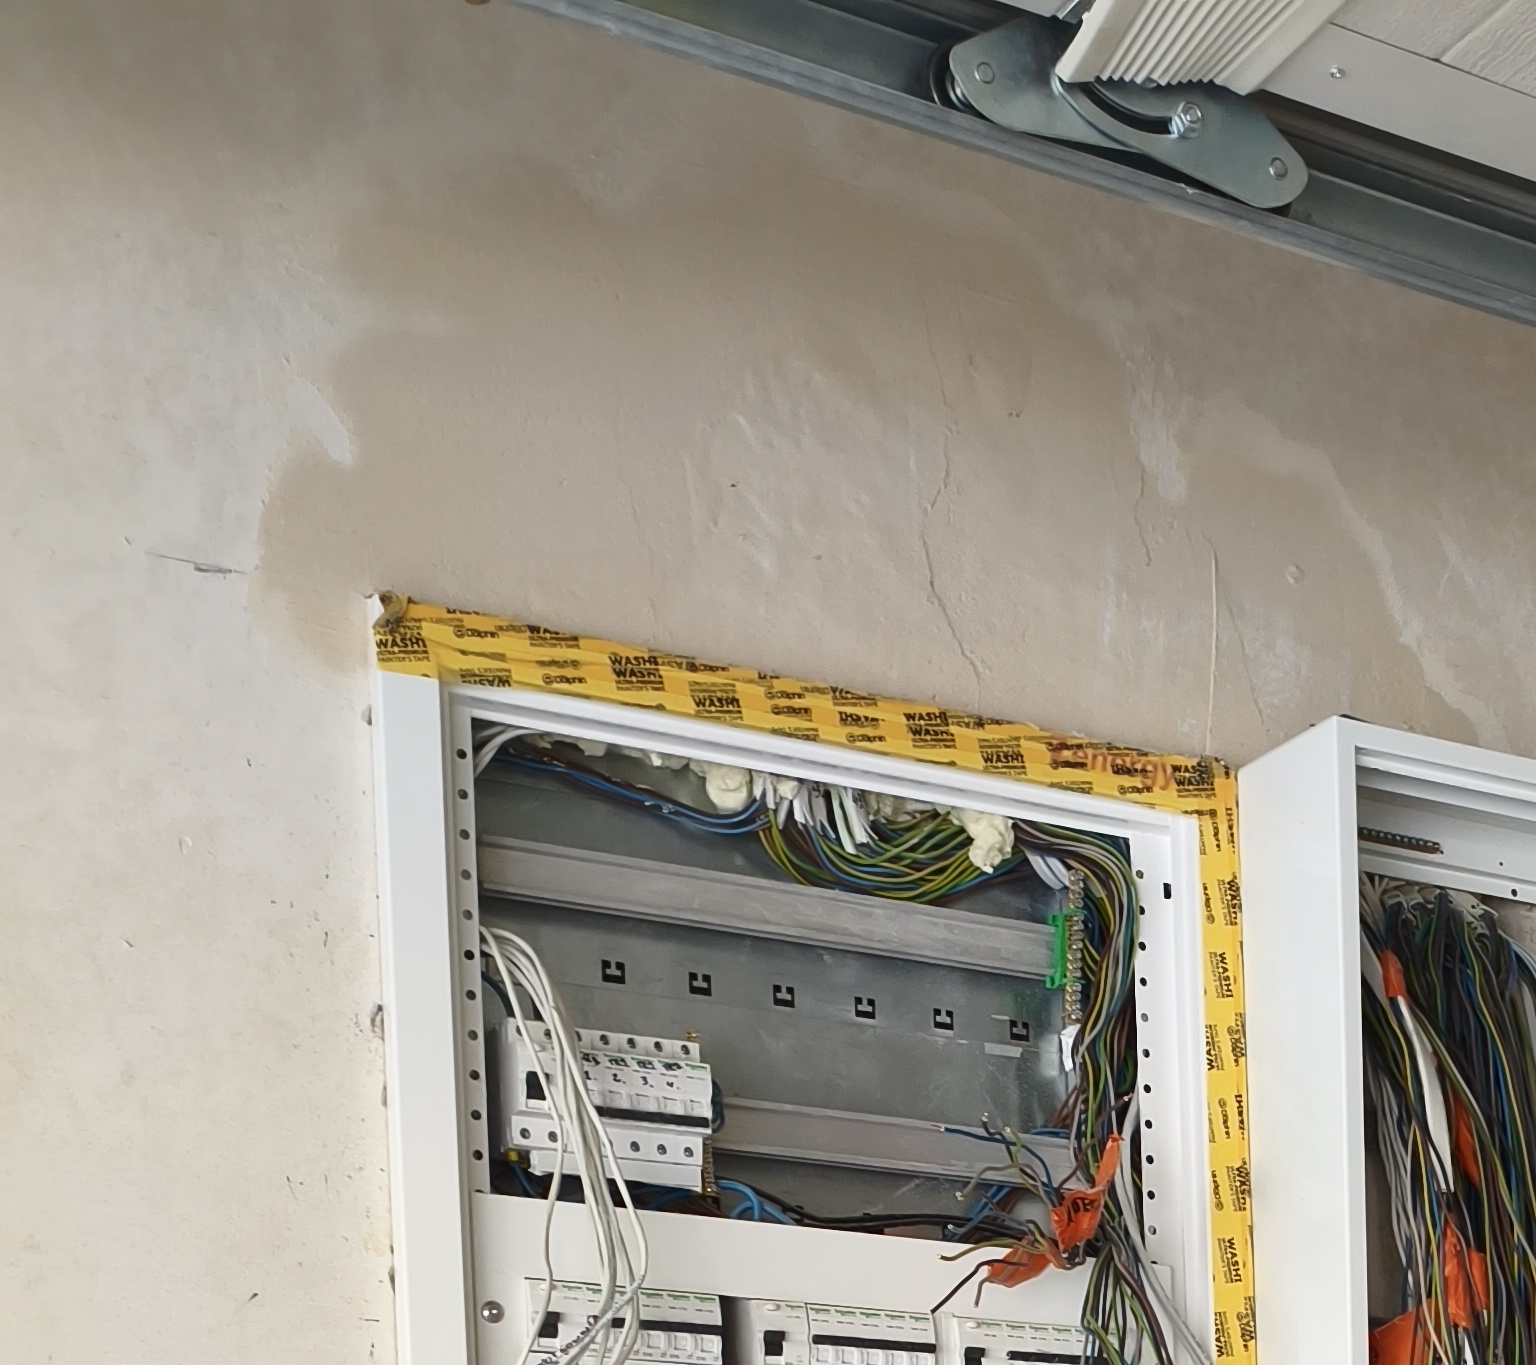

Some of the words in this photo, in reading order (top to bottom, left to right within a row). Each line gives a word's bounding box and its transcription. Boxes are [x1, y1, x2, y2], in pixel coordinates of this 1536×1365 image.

[1219, 952, 1234, 998] WASHI
[1211, 1171, 1220, 1199] Dolphin
[1227, 1238, 1242, 1282] WASHI
